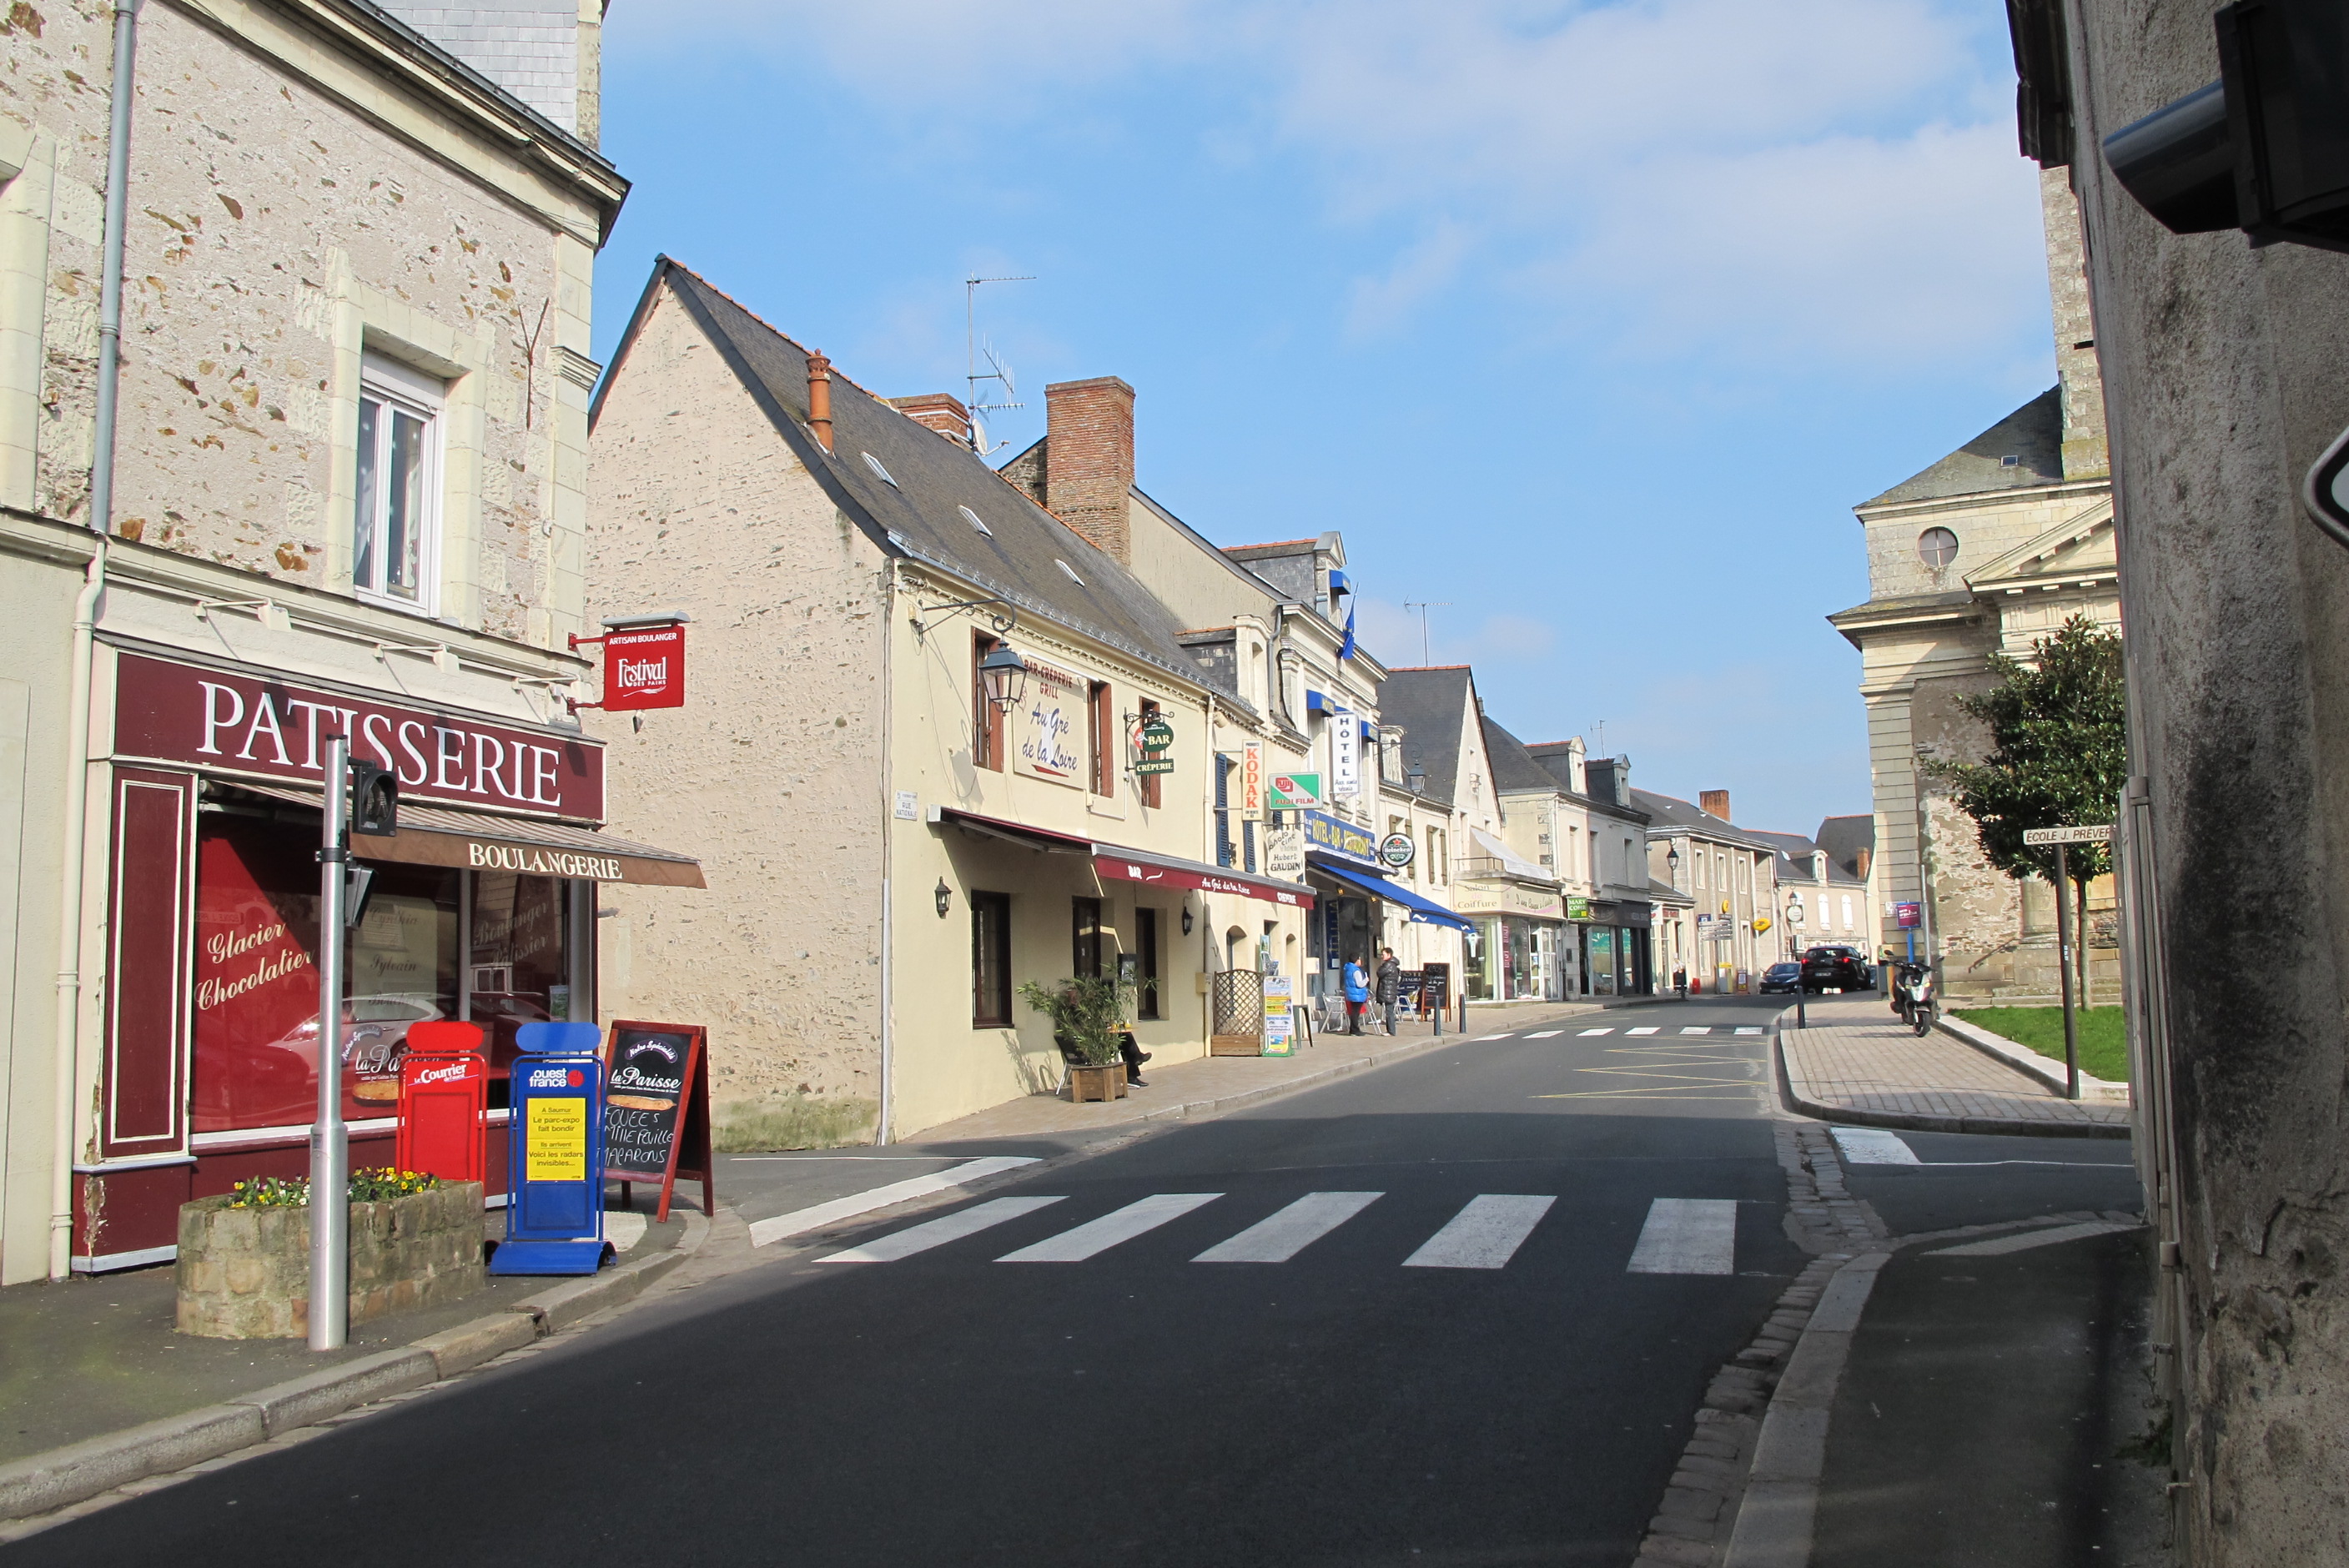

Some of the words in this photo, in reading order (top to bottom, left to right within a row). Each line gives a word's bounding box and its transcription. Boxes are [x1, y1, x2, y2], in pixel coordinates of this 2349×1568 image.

[609, 636, 636, 646] ARTISAN
[637, 632, 677, 643] BOULANGER
[617, 656, 667, 687] Festival
[1039, 681, 1059, 700] GRILL
[1030, 701, 1048, 727] Au
[1050, 708, 1069, 740] Gré
[196, 681, 562, 807] PATISSERIE
[1148, 735, 1170, 746] BAR
[1340, 717, 1351, 776] HÔTEL
[1023, 736, 1034, 758] de
[1037, 739, 1048, 763] la
[1050, 743, 1078, 771] Loire
[1136, 762, 1174, 771] CRÊPERIE
[1246, 748, 1259, 808] KODAK
[1269, 832, 1289, 852] photo
[2026, 830, 2057, 842] ÉCOLE
[2061, 832, 2069, 840] J.
[468, 843, 622, 880] BOULANGERIE
[1270, 862, 1300, 871] GAUDIN
[1128, 866, 1142, 880] BAR
[1457, 900, 1497, 909] Coiffure
[473, 902, 549, 947] Boulanger
[208, 922, 286, 964] Glacier
[194, 948, 315, 1010] Chocolatier
[355, 1050, 370, 1071] la
[629, 1044, 646, 1058] Notre
[420, 1063, 467, 1083] Courrier
[529, 1076, 567, 1088] france
[534, 1068, 567, 1078] ouest
[611, 1069, 622, 1083] la
[622, 1067, 682, 1089] Parisse
[544, 1117, 581, 1126] parc-expo
